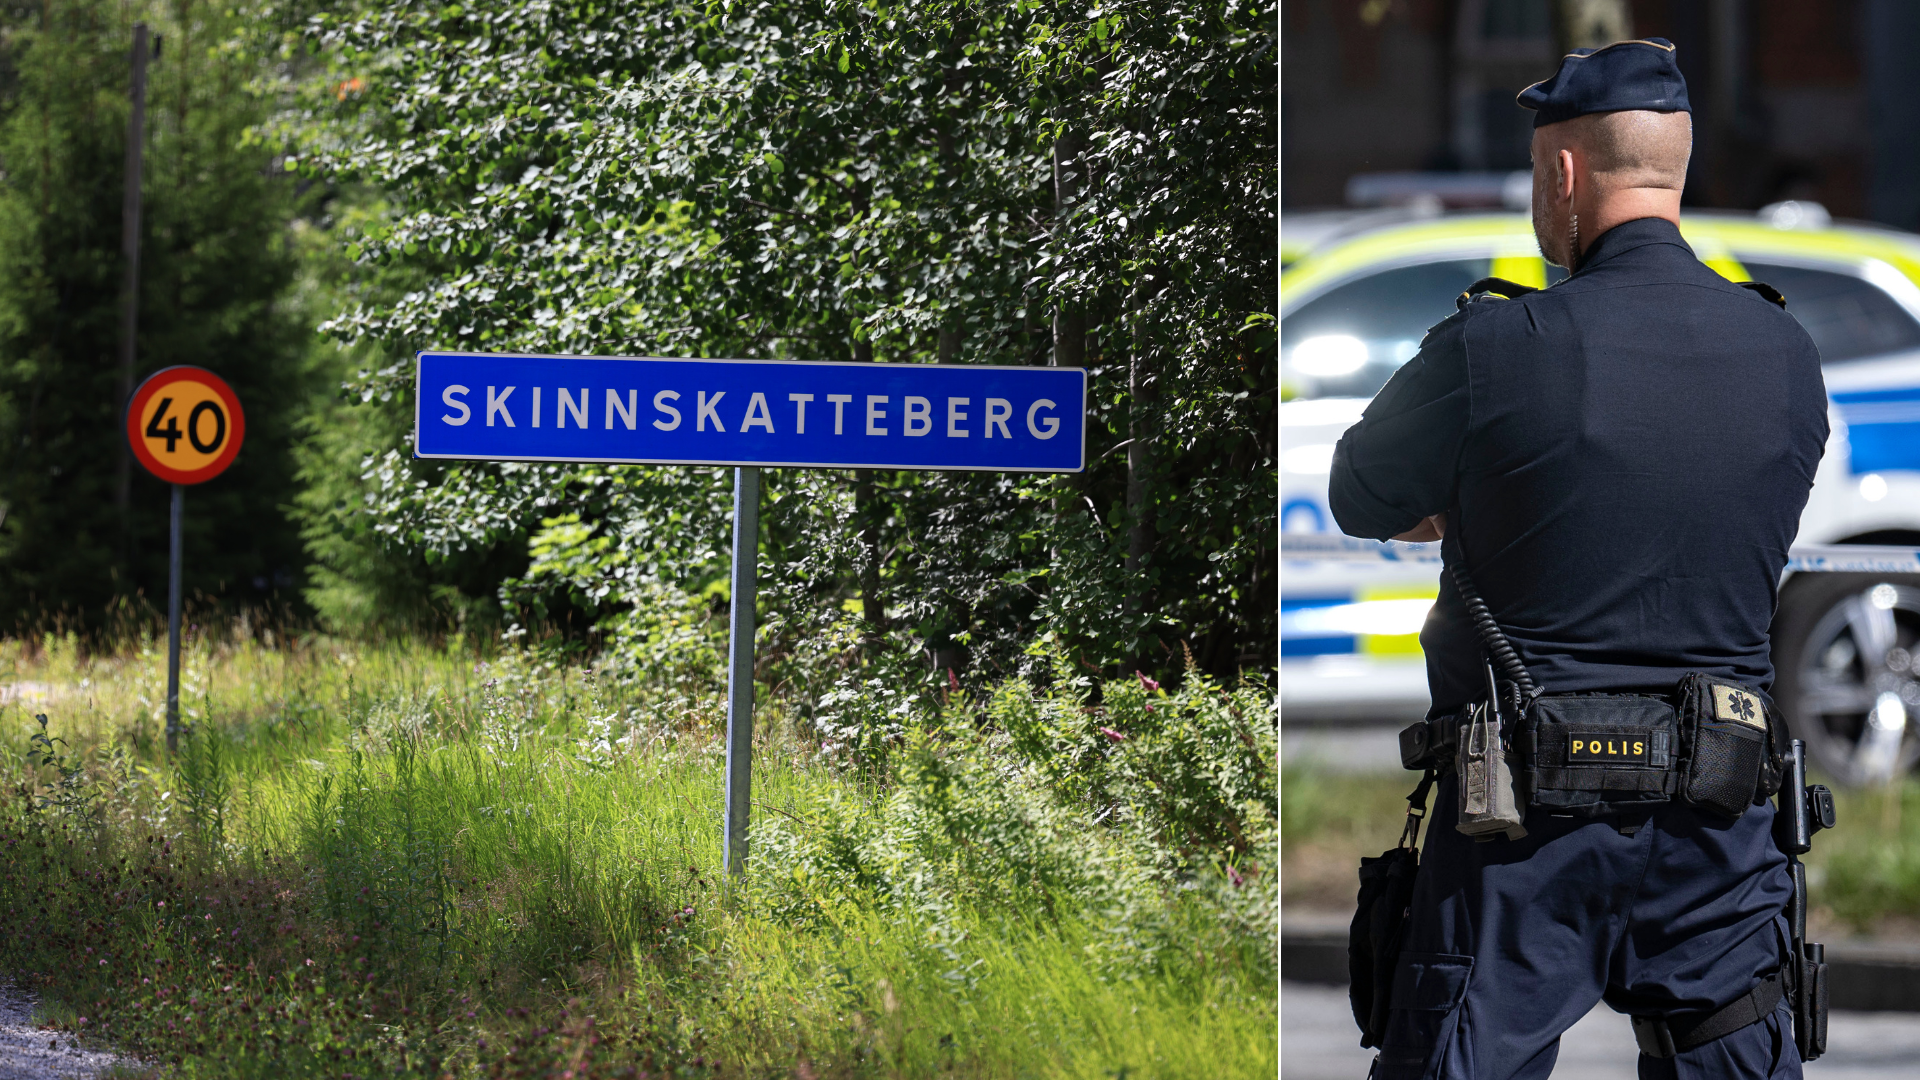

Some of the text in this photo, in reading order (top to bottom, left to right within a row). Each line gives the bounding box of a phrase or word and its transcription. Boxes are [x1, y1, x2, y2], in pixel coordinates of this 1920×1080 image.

[145, 397, 226, 455] 40
[441, 384, 1061, 440] SKINNSKATTEBERG
[1572, 740, 1644, 756] POLIS
